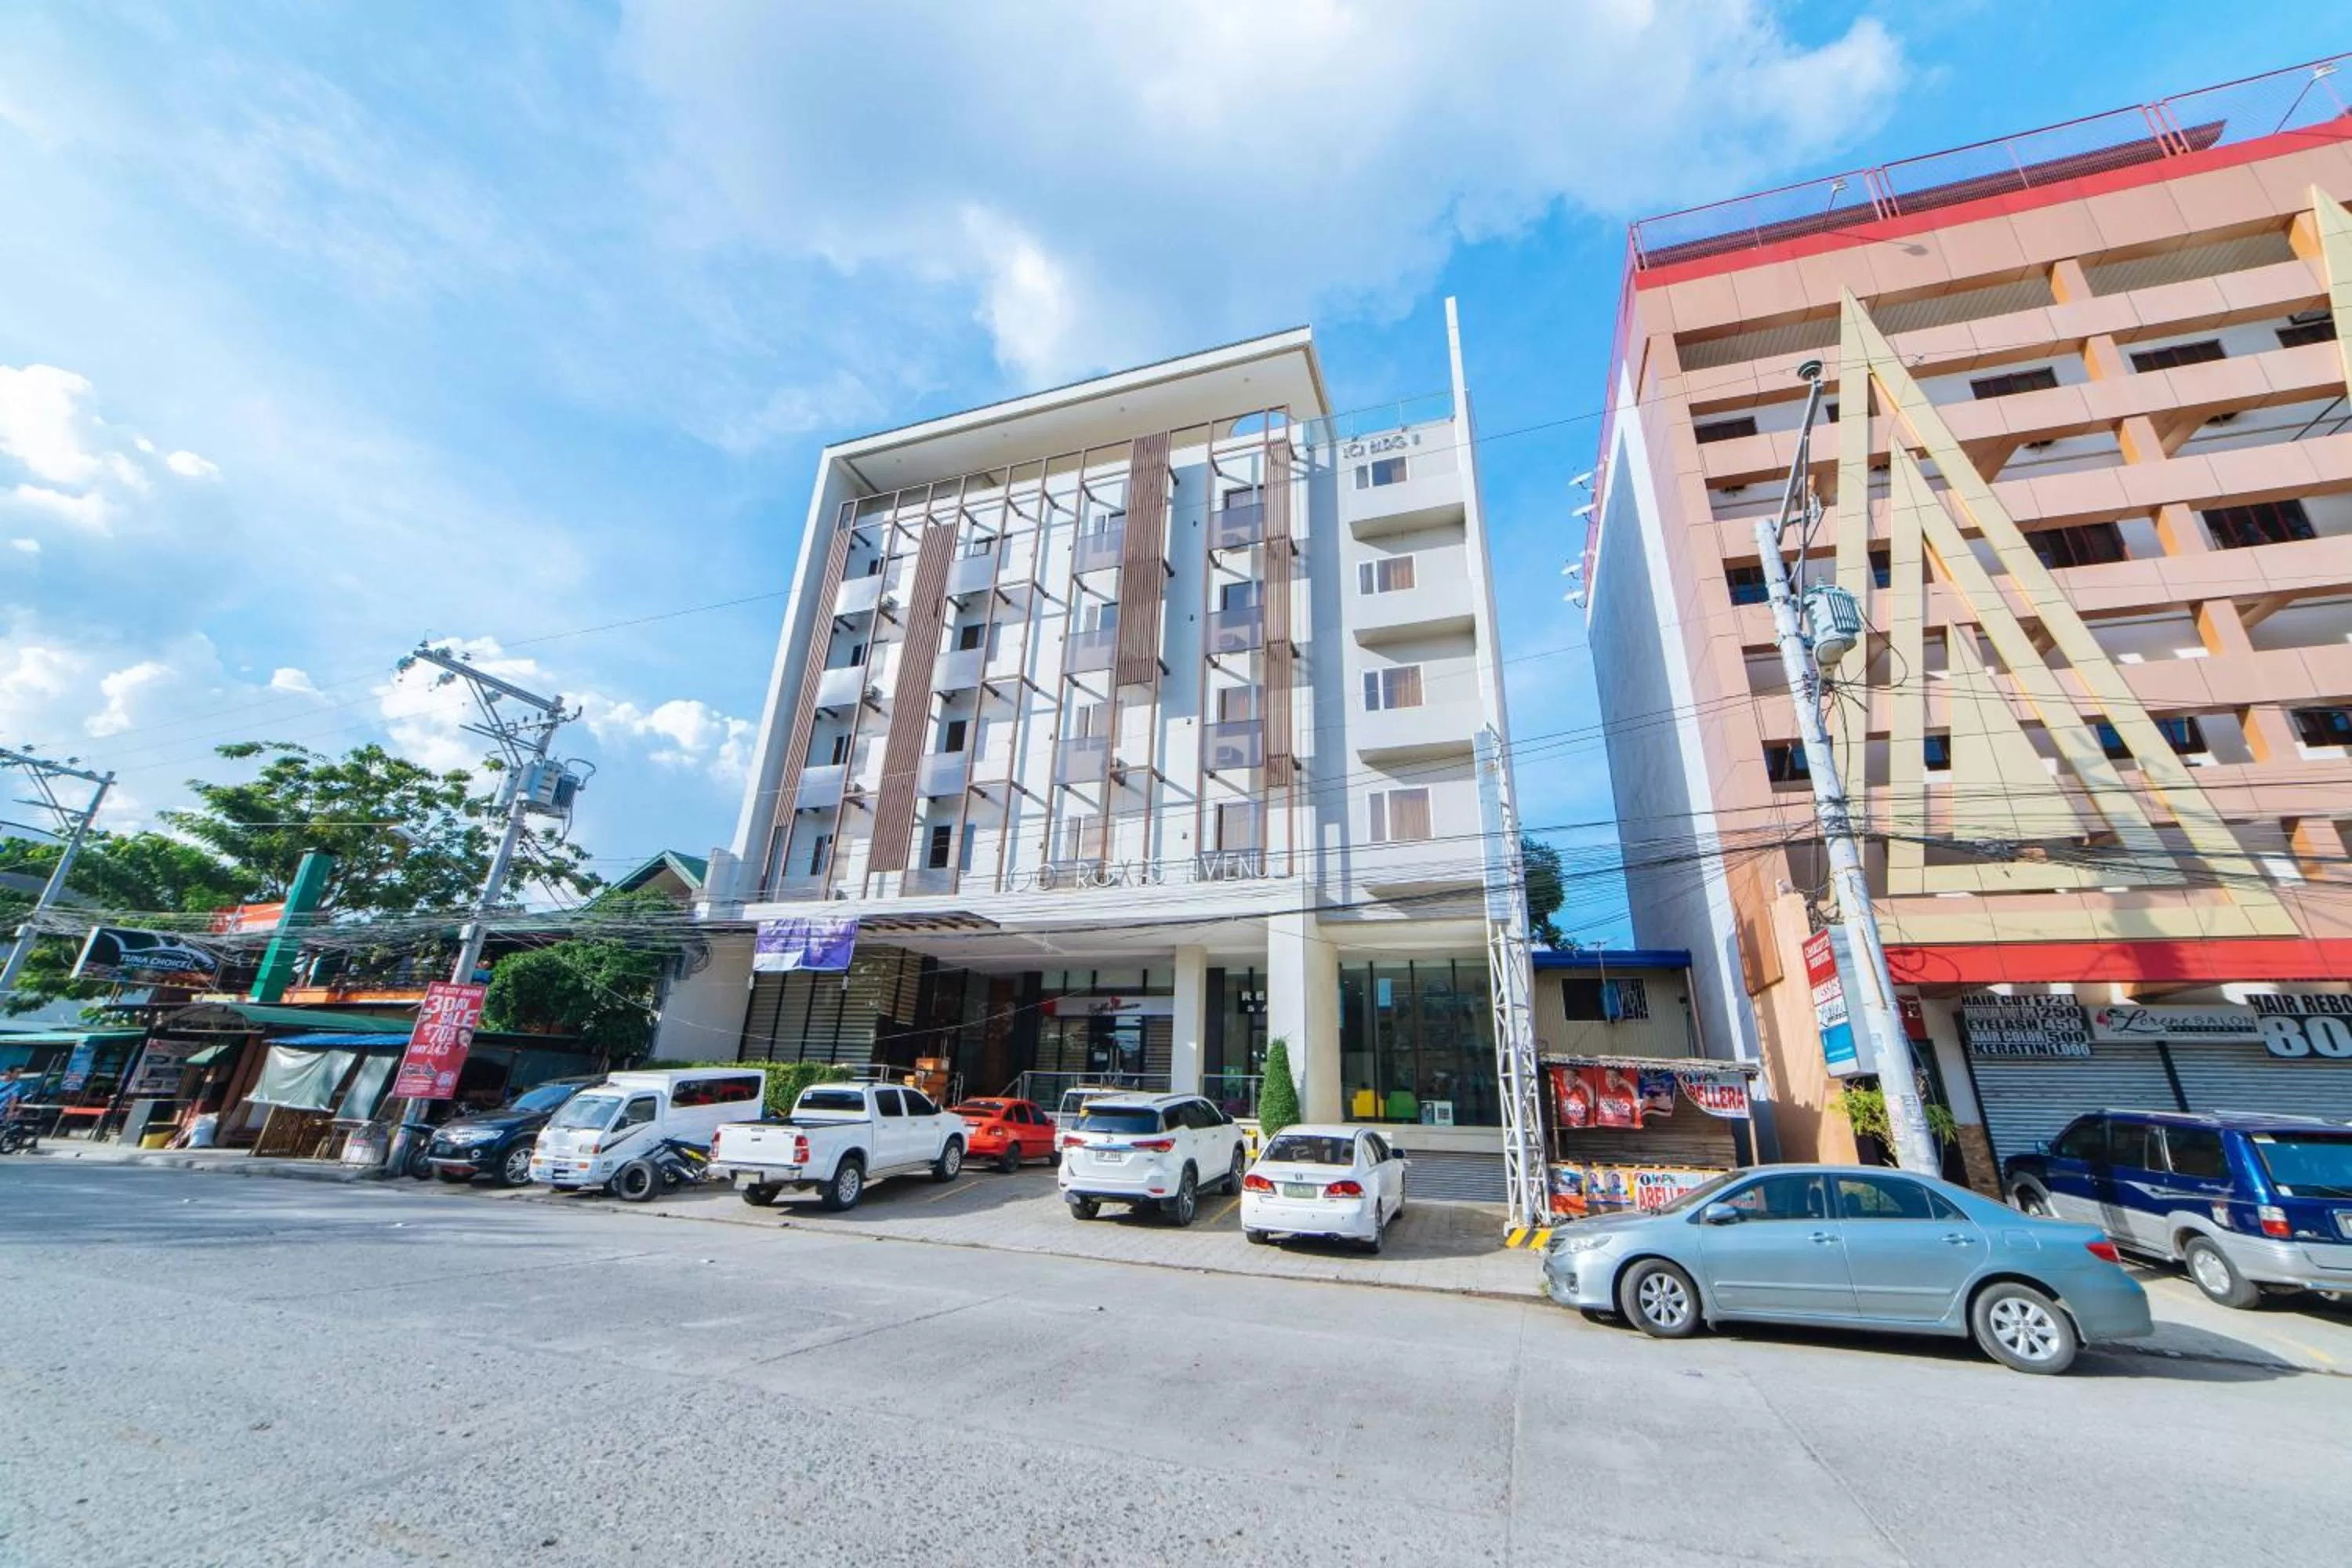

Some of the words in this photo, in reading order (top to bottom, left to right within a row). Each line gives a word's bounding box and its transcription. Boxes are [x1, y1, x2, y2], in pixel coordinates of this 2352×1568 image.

[1962, 995, 1998, 1006] HAIR
[2000, 995, 2031, 1006] CUT
[2038, 994, 2074, 1006] 120
[2244, 994, 2300, 1013] HAIR
[439, 1009, 478, 1027] SALE
[2041, 1007, 2078, 1018] 250
[1966, 1019, 2038, 1030] EYELASH
[2045, 1019, 2083, 1030] 450
[2194, 1015, 2256, 1026] SALON
[1970, 1031, 2001, 1042] HAIR
[2003, 1031, 2045, 1042] COLOR
[2047, 1031, 2086, 1042] 500
[1973, 1044, 2048, 1054] KERATIN
